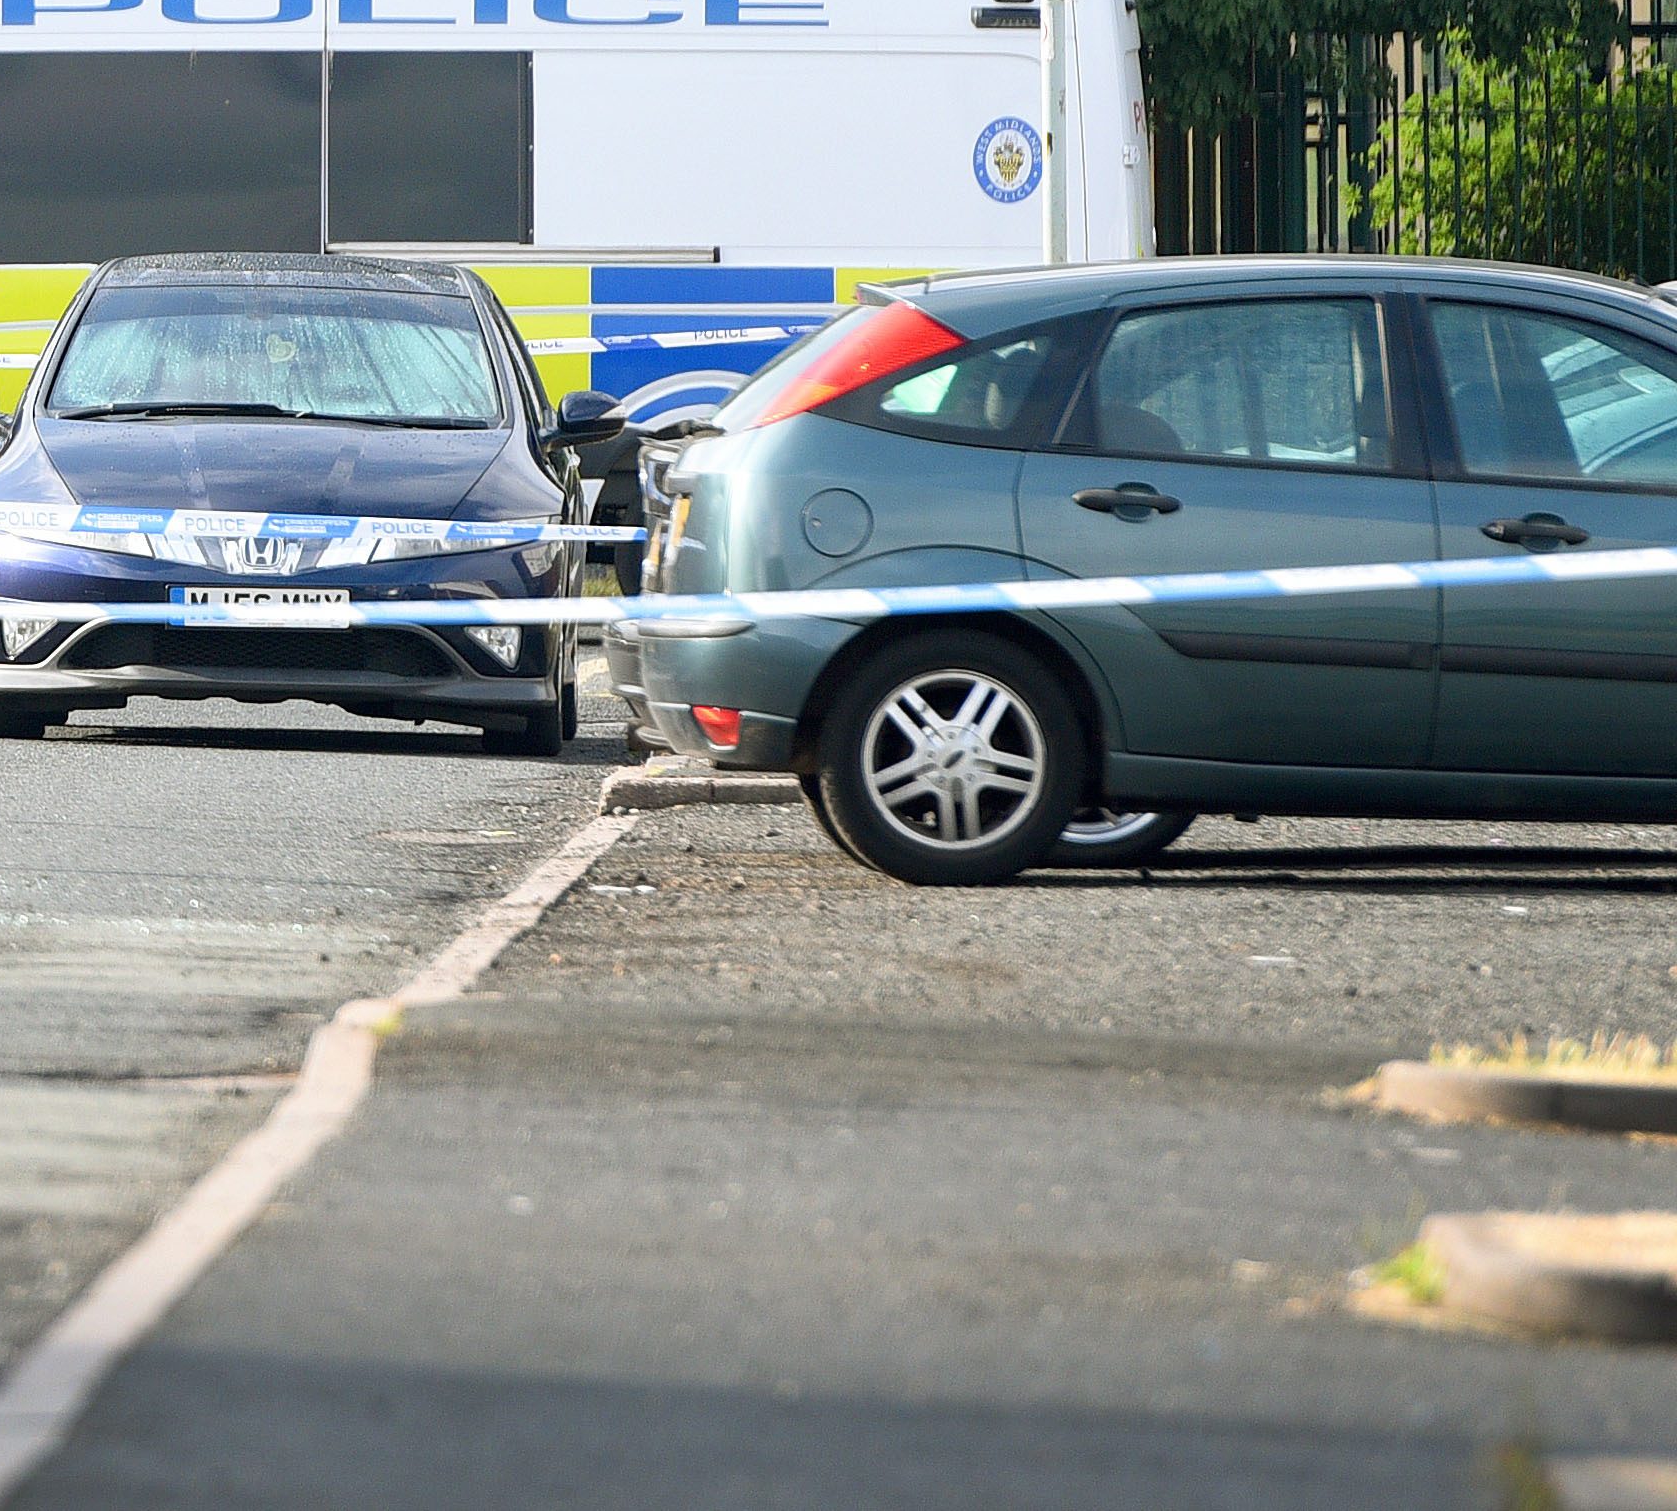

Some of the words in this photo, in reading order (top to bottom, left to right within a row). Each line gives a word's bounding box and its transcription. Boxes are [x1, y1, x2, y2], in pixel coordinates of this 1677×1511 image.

[976, 129, 993, 164] WEST
[995, 119, 1042, 163] MIDLANDS
[986, 182, 1033, 201] POLICE
[694, 328, 749, 341] POLICE
[184, 516, 246, 532] POLICE
[372, 521, 434, 534] POLICE
